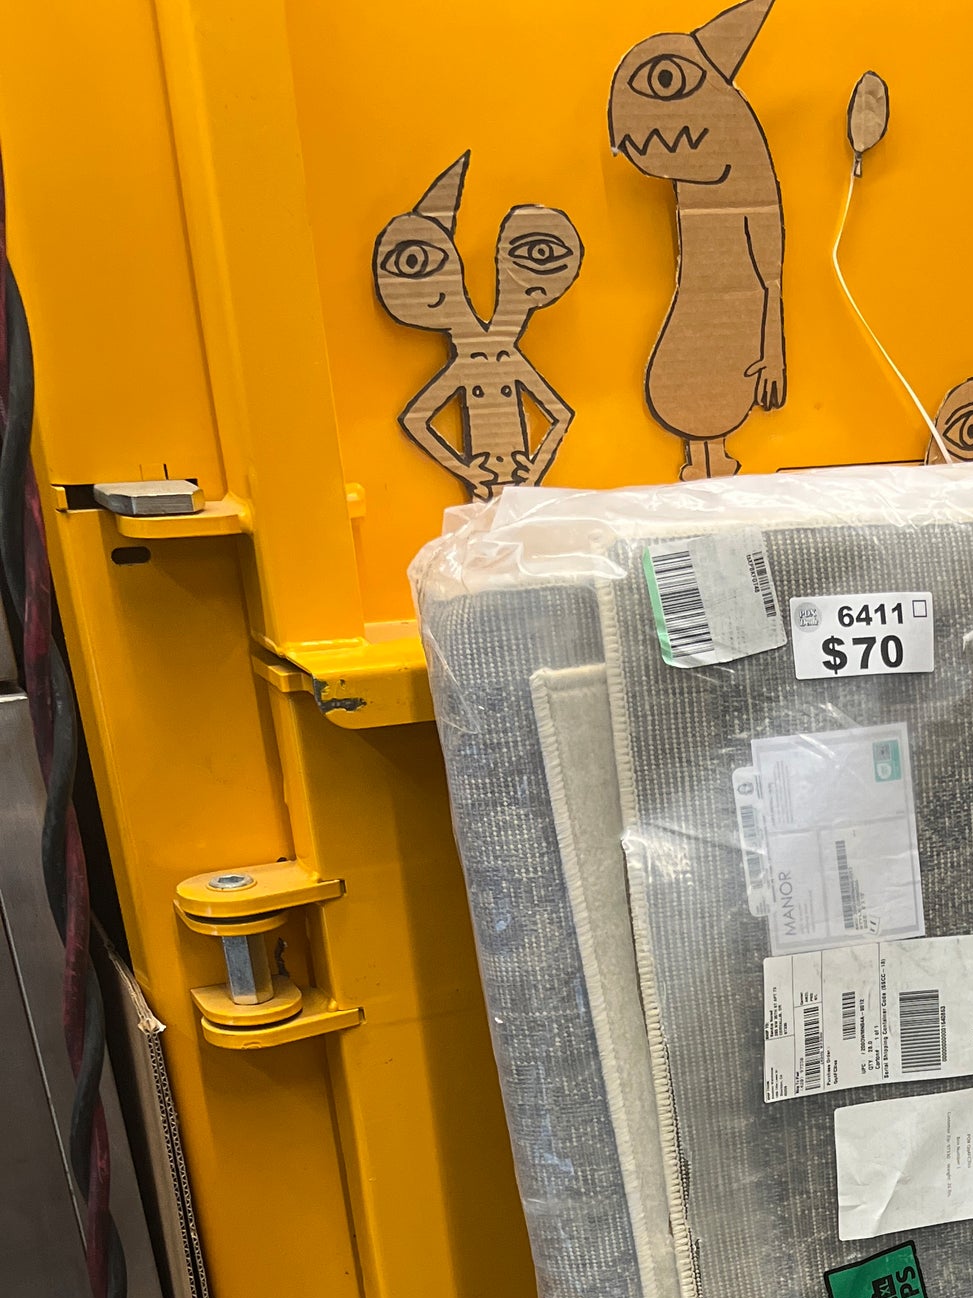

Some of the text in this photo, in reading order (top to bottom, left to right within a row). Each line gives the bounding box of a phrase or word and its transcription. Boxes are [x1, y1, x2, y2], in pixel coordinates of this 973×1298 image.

[837, 602, 904, 627] 6411
[822, 634, 904, 675] $70
[879, 1279, 891, 1297] XL
